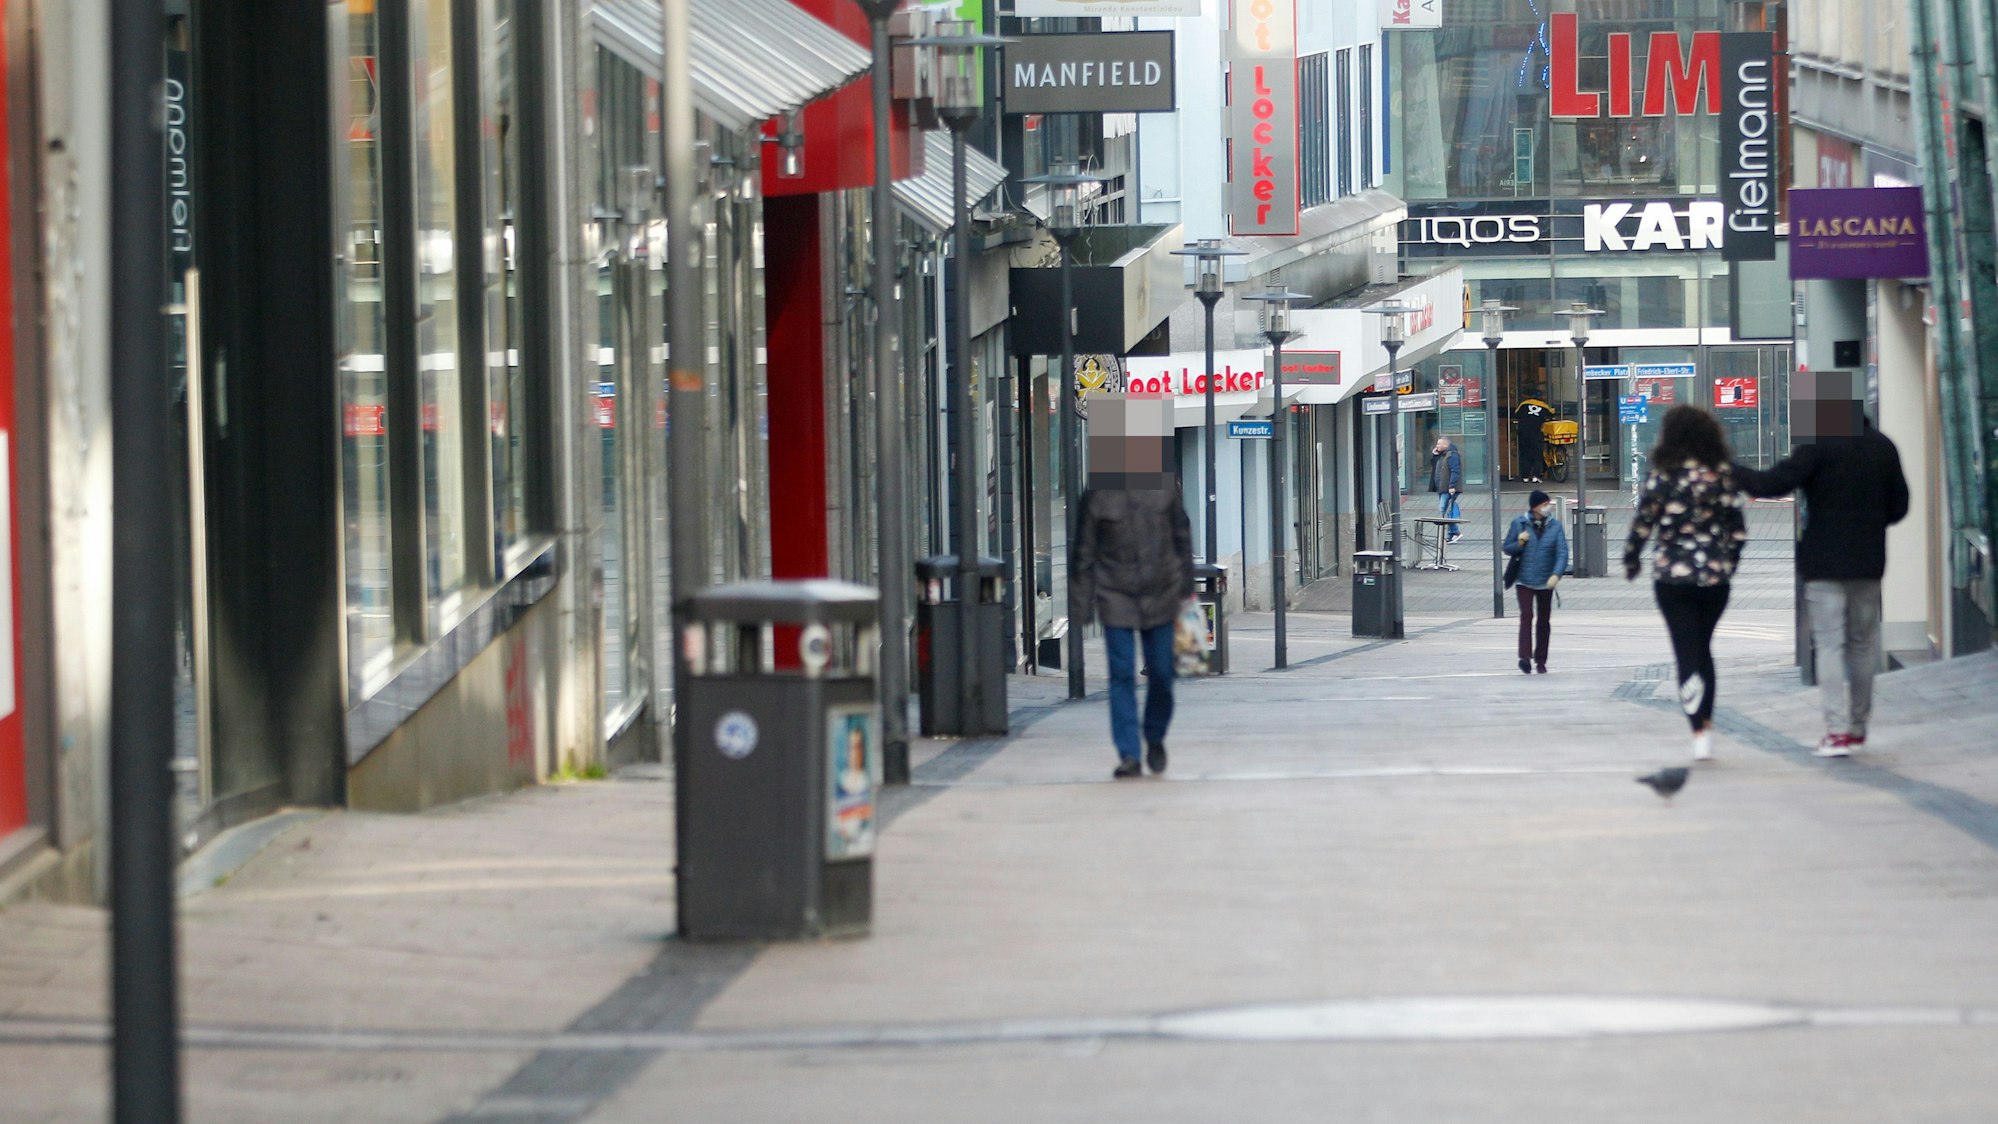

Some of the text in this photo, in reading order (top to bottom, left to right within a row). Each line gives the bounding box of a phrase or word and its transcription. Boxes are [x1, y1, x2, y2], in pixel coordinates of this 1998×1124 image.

[1084, 5, 1117, 13] Miranda
[1014, 61, 1161, 88] MANFIELD
[1550, 12, 1723, 118] LIM
[1252, 66, 1275, 225] Locker
[1728, 60, 1769, 232] fielmann
[1420, 215, 1540, 249] IQOS
[1798, 216, 1917, 237] LASCANA
[1126, 370, 1172, 394] oot
[1181, 366, 1264, 395] Locker
[1281, 363, 1299, 373] oot
[1585, 368, 1611, 377] mbecker
[1233, 425, 1271, 435] Kunzestr.
